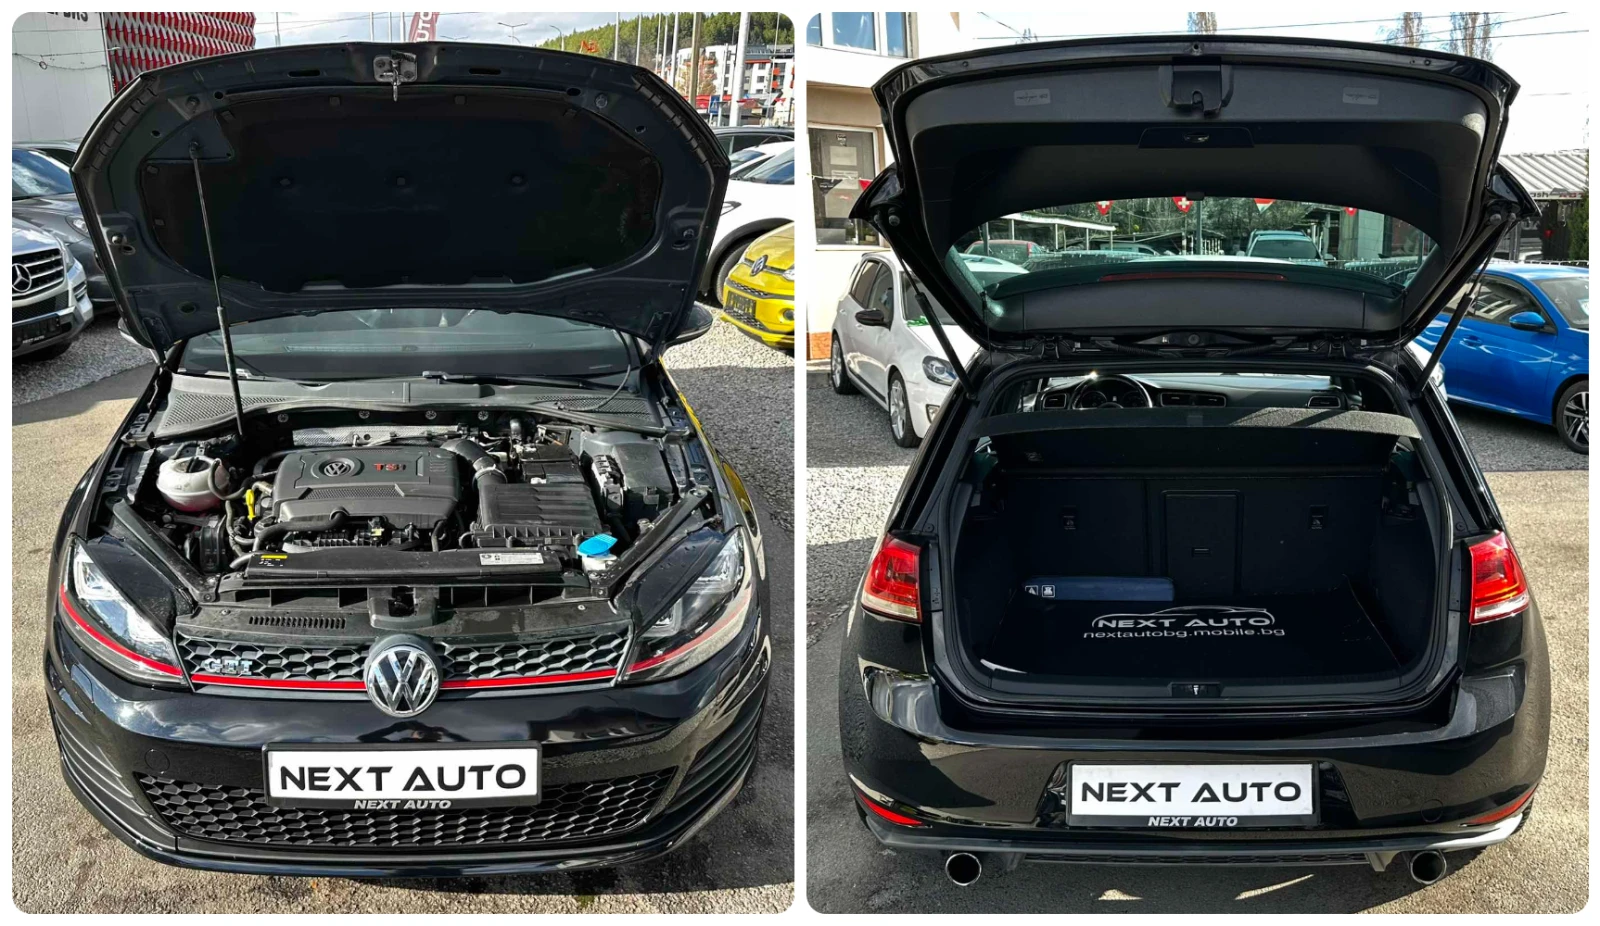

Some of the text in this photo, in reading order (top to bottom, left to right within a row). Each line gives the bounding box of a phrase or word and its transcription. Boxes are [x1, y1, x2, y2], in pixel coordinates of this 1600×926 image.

[1098, 617, 1271, 628] NEXT AUTO
[1083, 628, 1286, 638] nextautobg.mobile.bg
[201, 657, 253, 675] GTI
[280, 763, 526, 792] NEXT AUTO
[1081, 781, 1301, 803] NEXT AUTO
[354, 800, 452, 810] NEXT AUTO
[1148, 816, 1238, 827] NEXT AUTO
